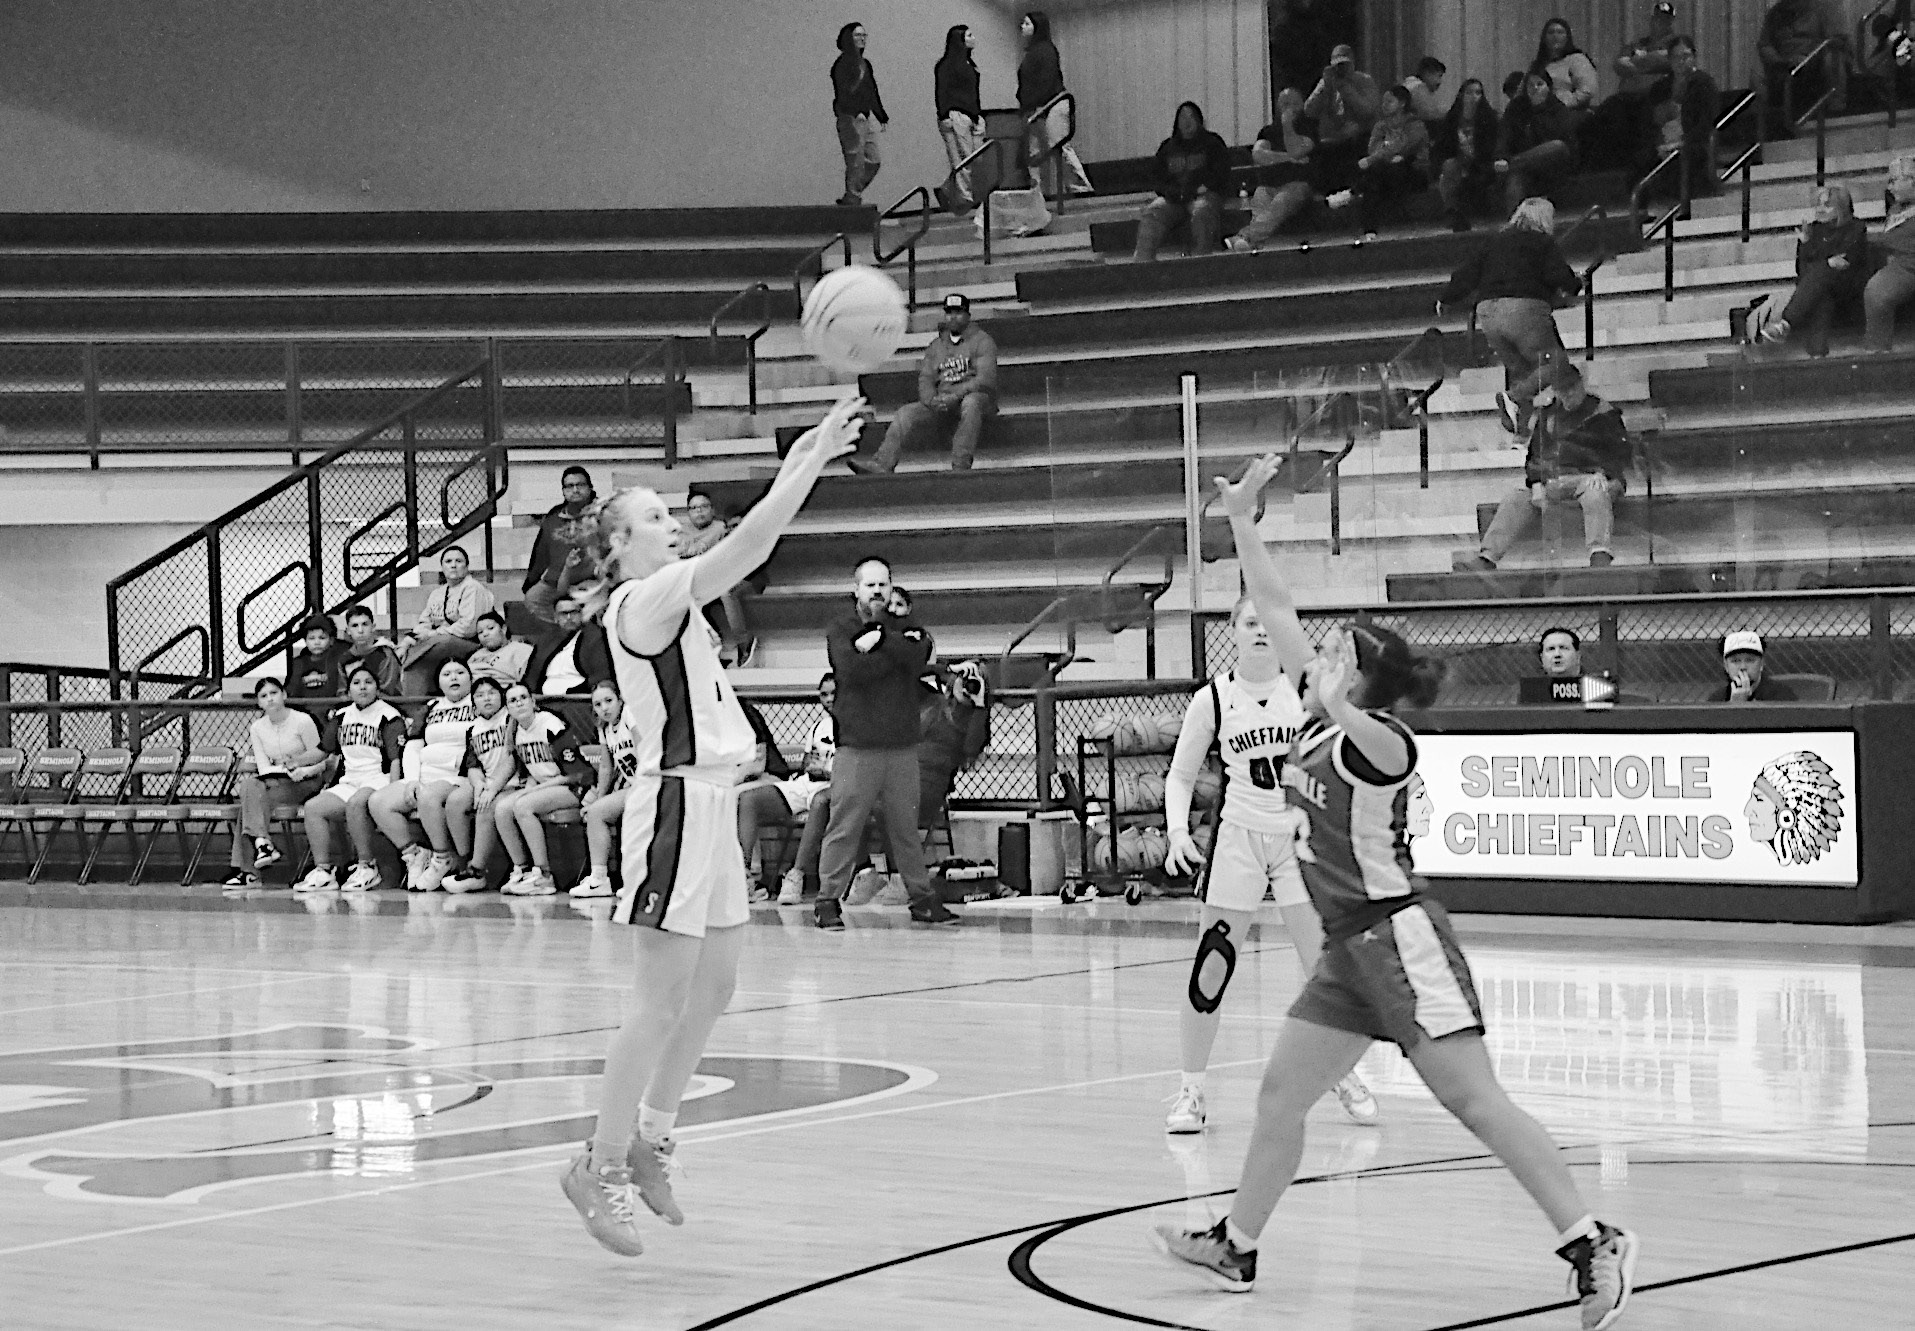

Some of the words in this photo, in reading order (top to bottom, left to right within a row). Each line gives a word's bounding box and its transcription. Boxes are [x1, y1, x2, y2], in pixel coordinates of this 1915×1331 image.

[1552, 682, 1581, 699] POSS.
[1460, 755, 1712, 799] SEMINOLE
[1443, 812, 1734, 860] CHIEFTAINS
